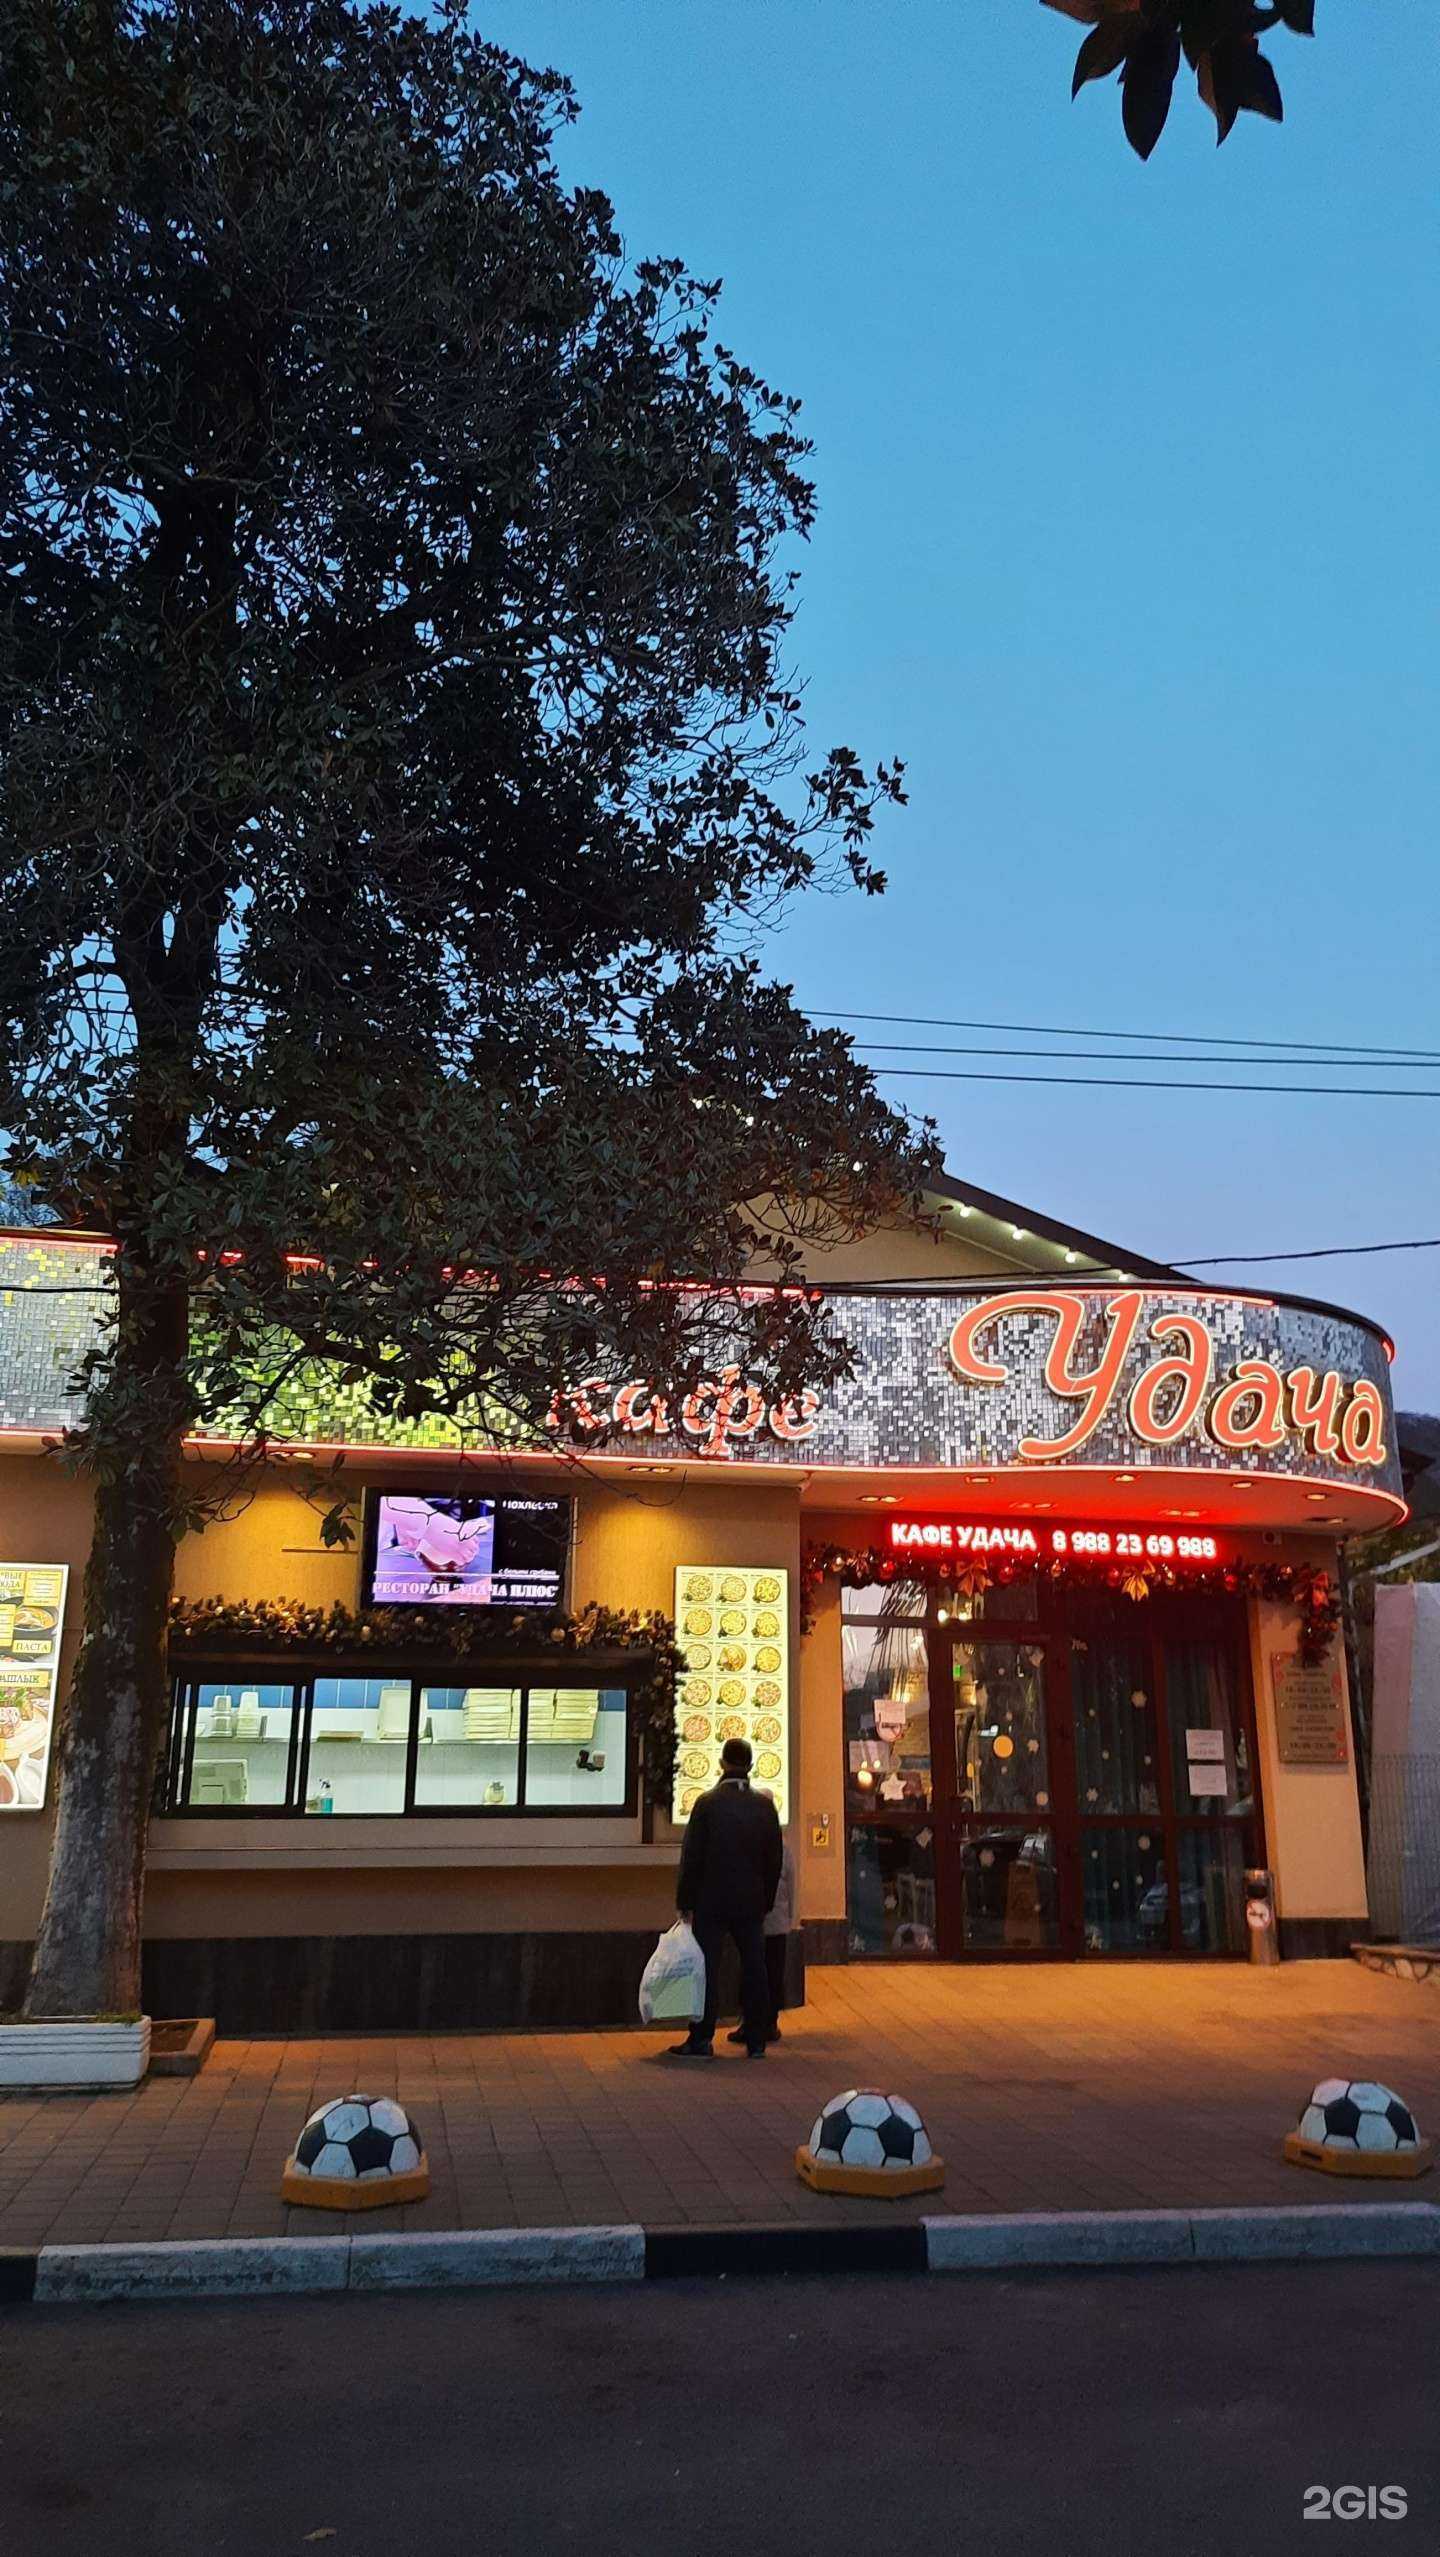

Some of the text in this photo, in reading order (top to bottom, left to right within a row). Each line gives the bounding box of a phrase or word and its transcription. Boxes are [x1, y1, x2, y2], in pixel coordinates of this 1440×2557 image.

[949, 1289, 1387, 1466] Удача
[891, 1523, 1217, 1559] КАФЕ УДАЧА 8 988 23 69 988
[373, 1582, 450, 1595] РЕСТОРАН
[15, 1643, 48, 1651] ПАСТА
